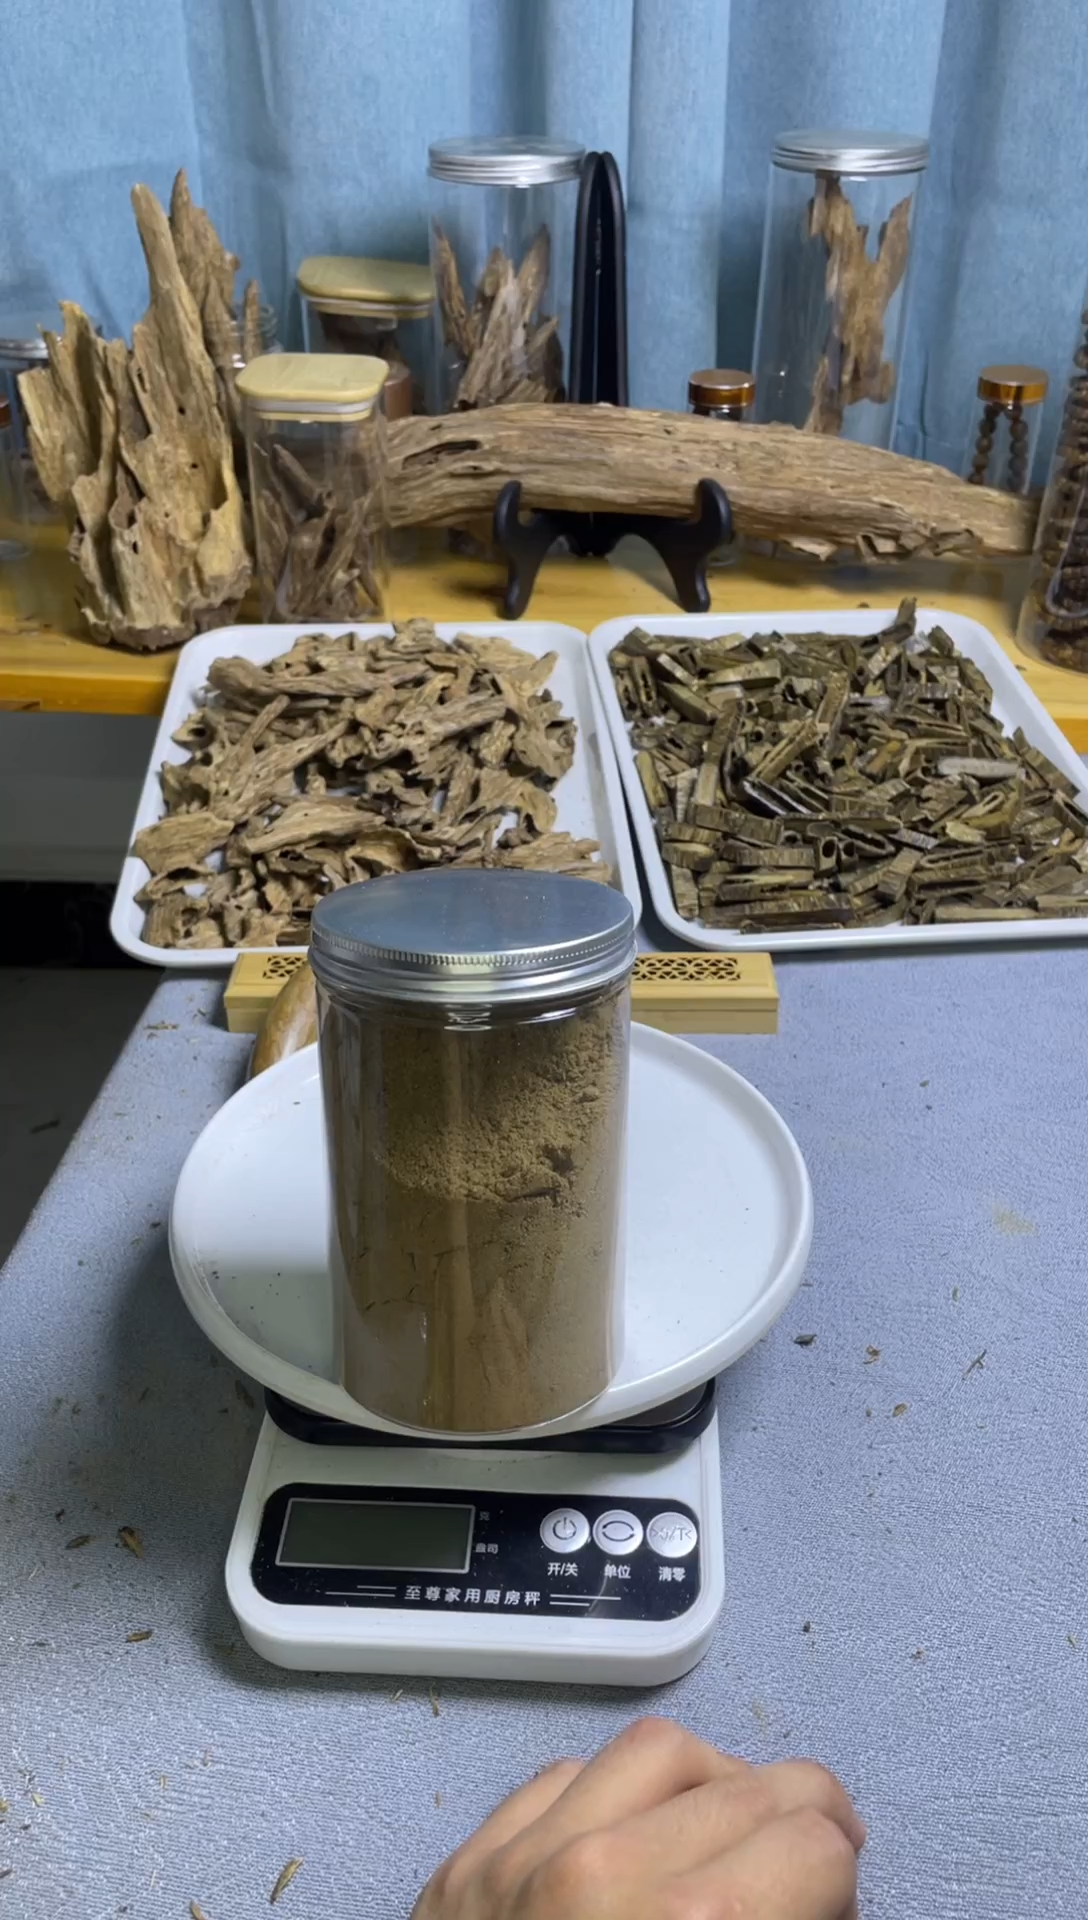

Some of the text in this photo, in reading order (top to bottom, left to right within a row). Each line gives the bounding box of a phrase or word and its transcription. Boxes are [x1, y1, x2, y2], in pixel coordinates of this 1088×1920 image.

[547, 1562, 579, 1577] 开/关
[604, 1563, 631, 1579] 单位
[658, 1566, 686, 1582] 清零
[404, 1585, 541, 1606] 至尊家用厨房秤
